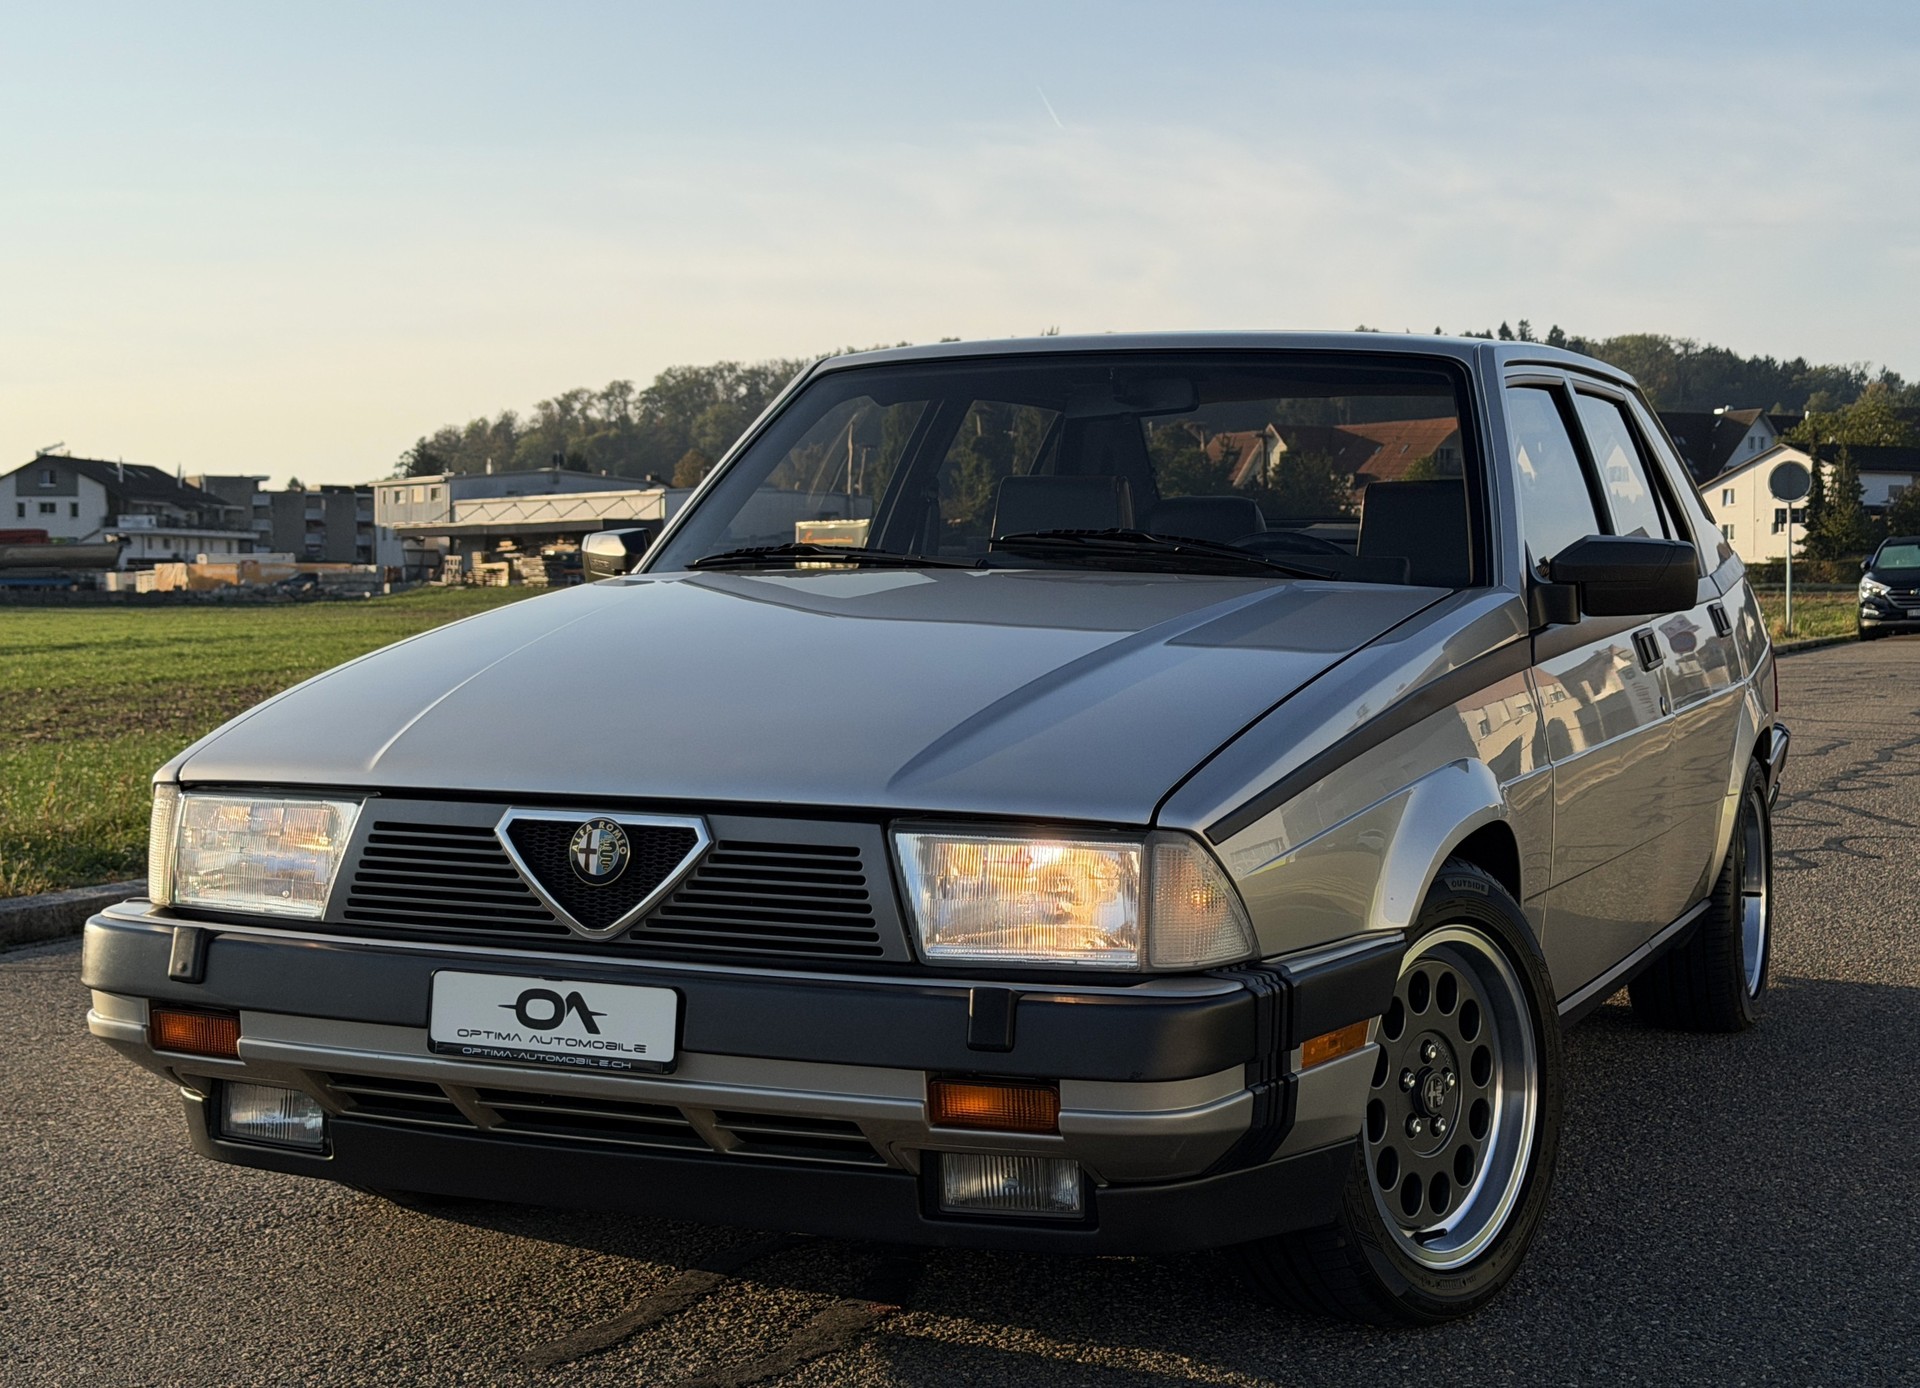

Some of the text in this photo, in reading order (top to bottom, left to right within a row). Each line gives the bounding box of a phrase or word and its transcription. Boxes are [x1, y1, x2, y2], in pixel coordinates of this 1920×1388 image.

[571, 821, 627, 855] ALFA ROMEO
[457, 1028, 647, 1054] OPTIMA AUTOMOBILE
[462, 1047, 632, 1070] OPTIMA-AUTOMOBILE.CH
